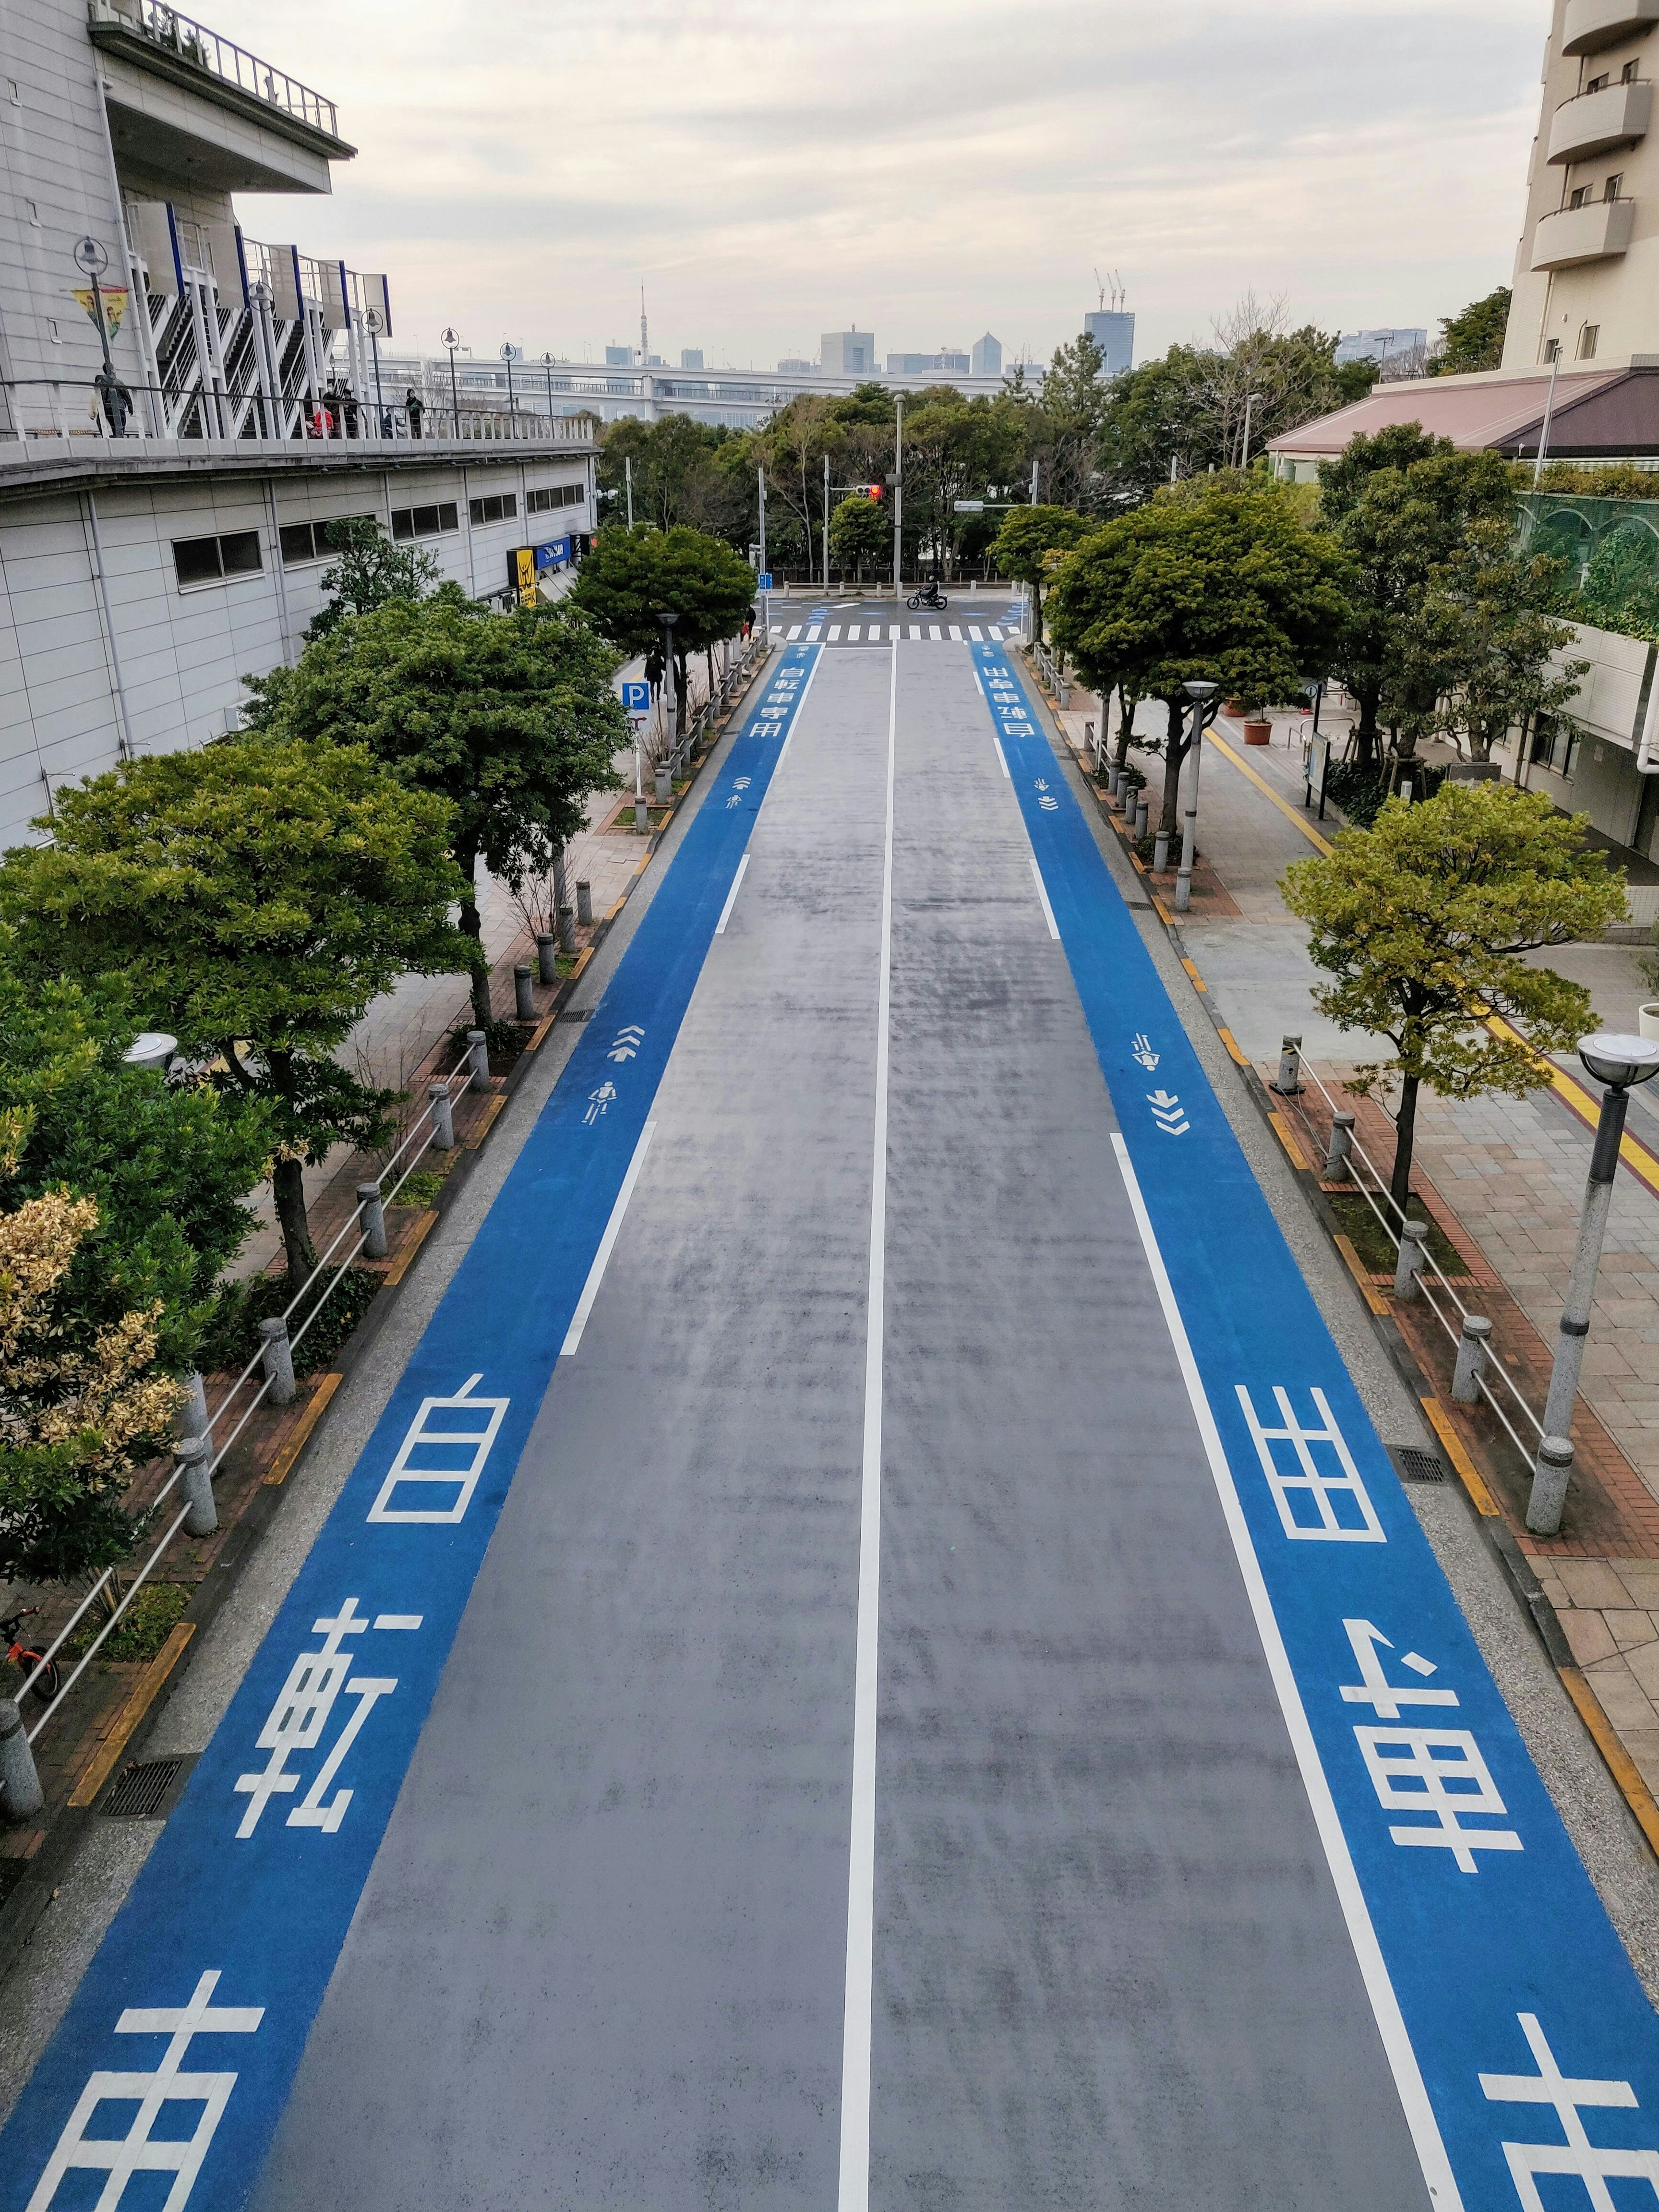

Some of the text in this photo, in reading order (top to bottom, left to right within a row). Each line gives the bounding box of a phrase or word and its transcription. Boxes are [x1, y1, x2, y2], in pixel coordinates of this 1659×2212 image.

[629, 685, 644, 708] P
[749, 667, 805, 737] 自転車専用
[983, 667, 1035, 737] 自転車専用
